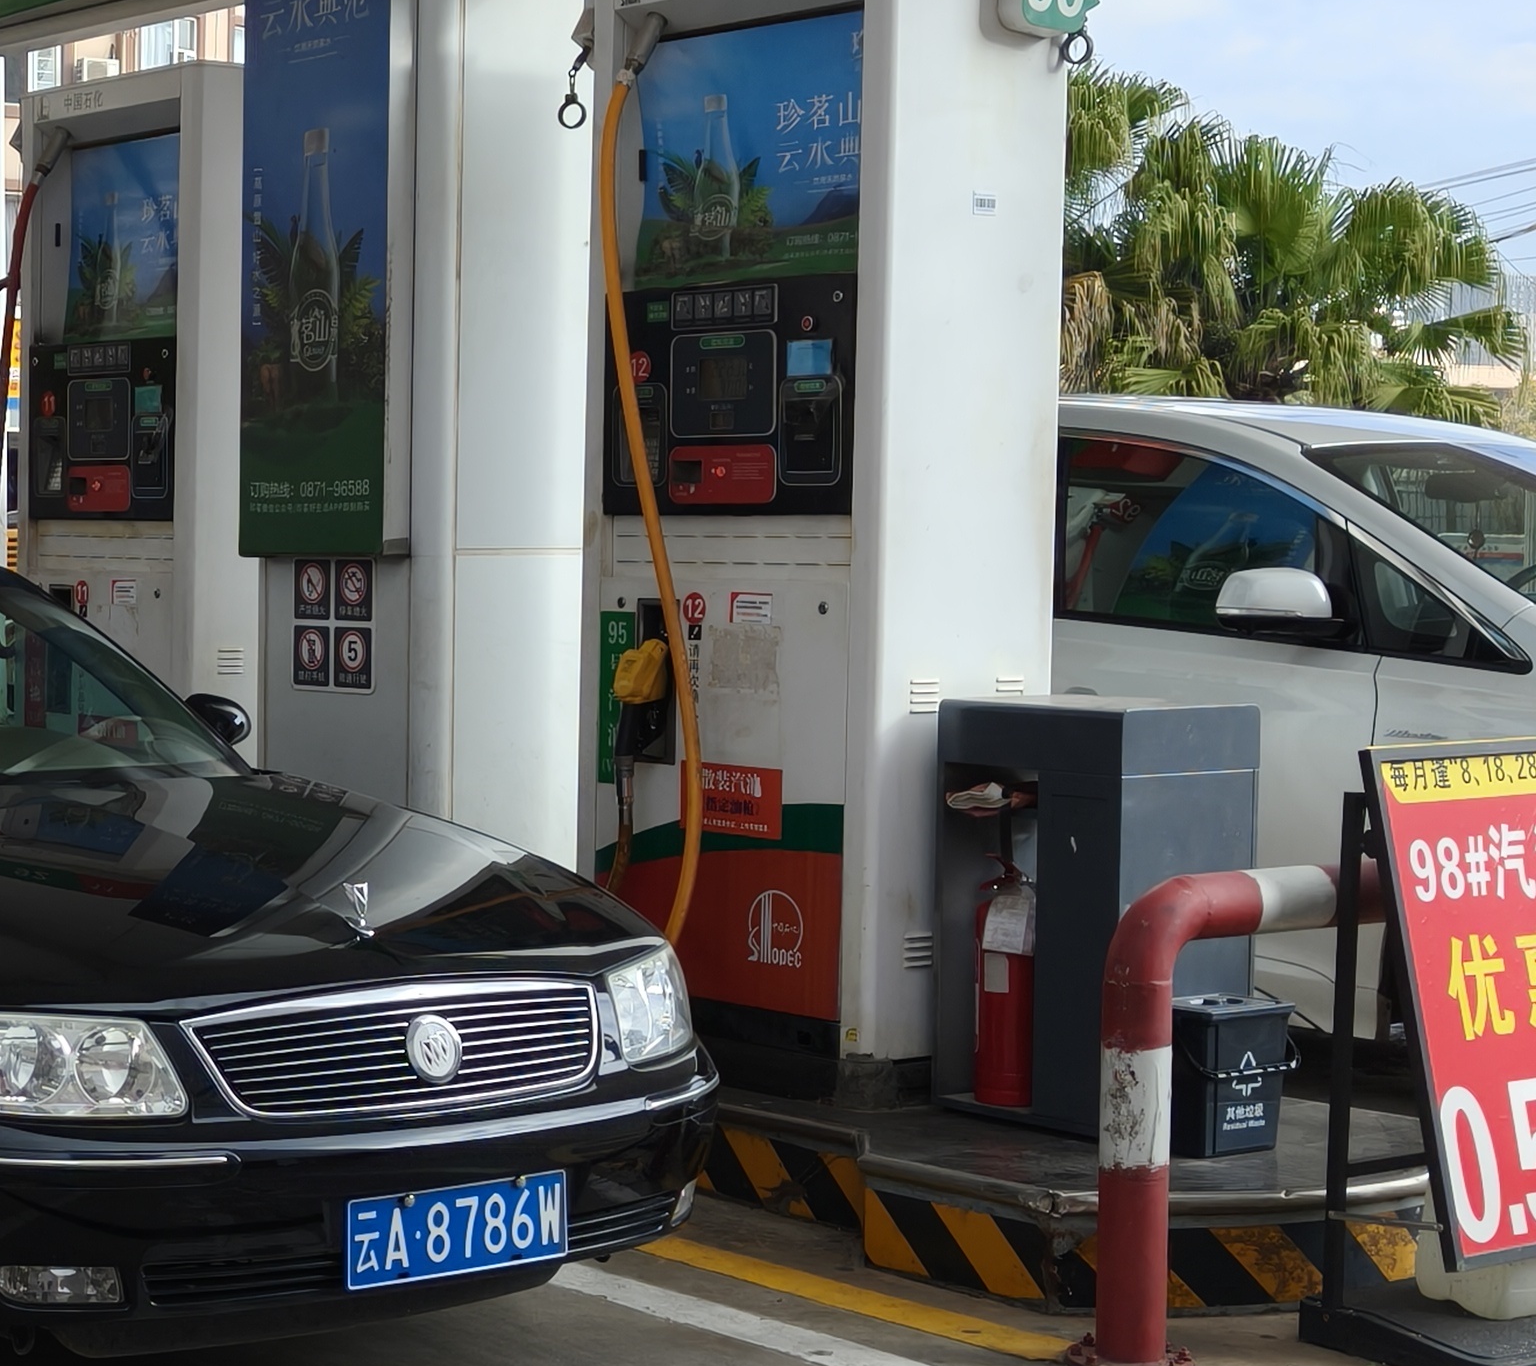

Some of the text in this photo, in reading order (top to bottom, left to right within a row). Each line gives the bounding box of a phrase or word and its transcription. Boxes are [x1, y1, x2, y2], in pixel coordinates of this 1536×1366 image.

[64, 90, 104, 111] 中国石化
[630, 358, 649, 378] 12
[43, 395, 56, 410] 11
[299, 479, 370, 497] 0871-96588
[77, 583, 88, 601] 11
[685, 598, 703, 619] 12
[608, 621, 627, 644] 95
[347, 640, 358, 662] 5
[1409, 823, 1536, 903] 98#汽
[1226, 1102, 1264, 1121] 其他垃圾
[354, 1183, 561, 1274] 云A·8786W
